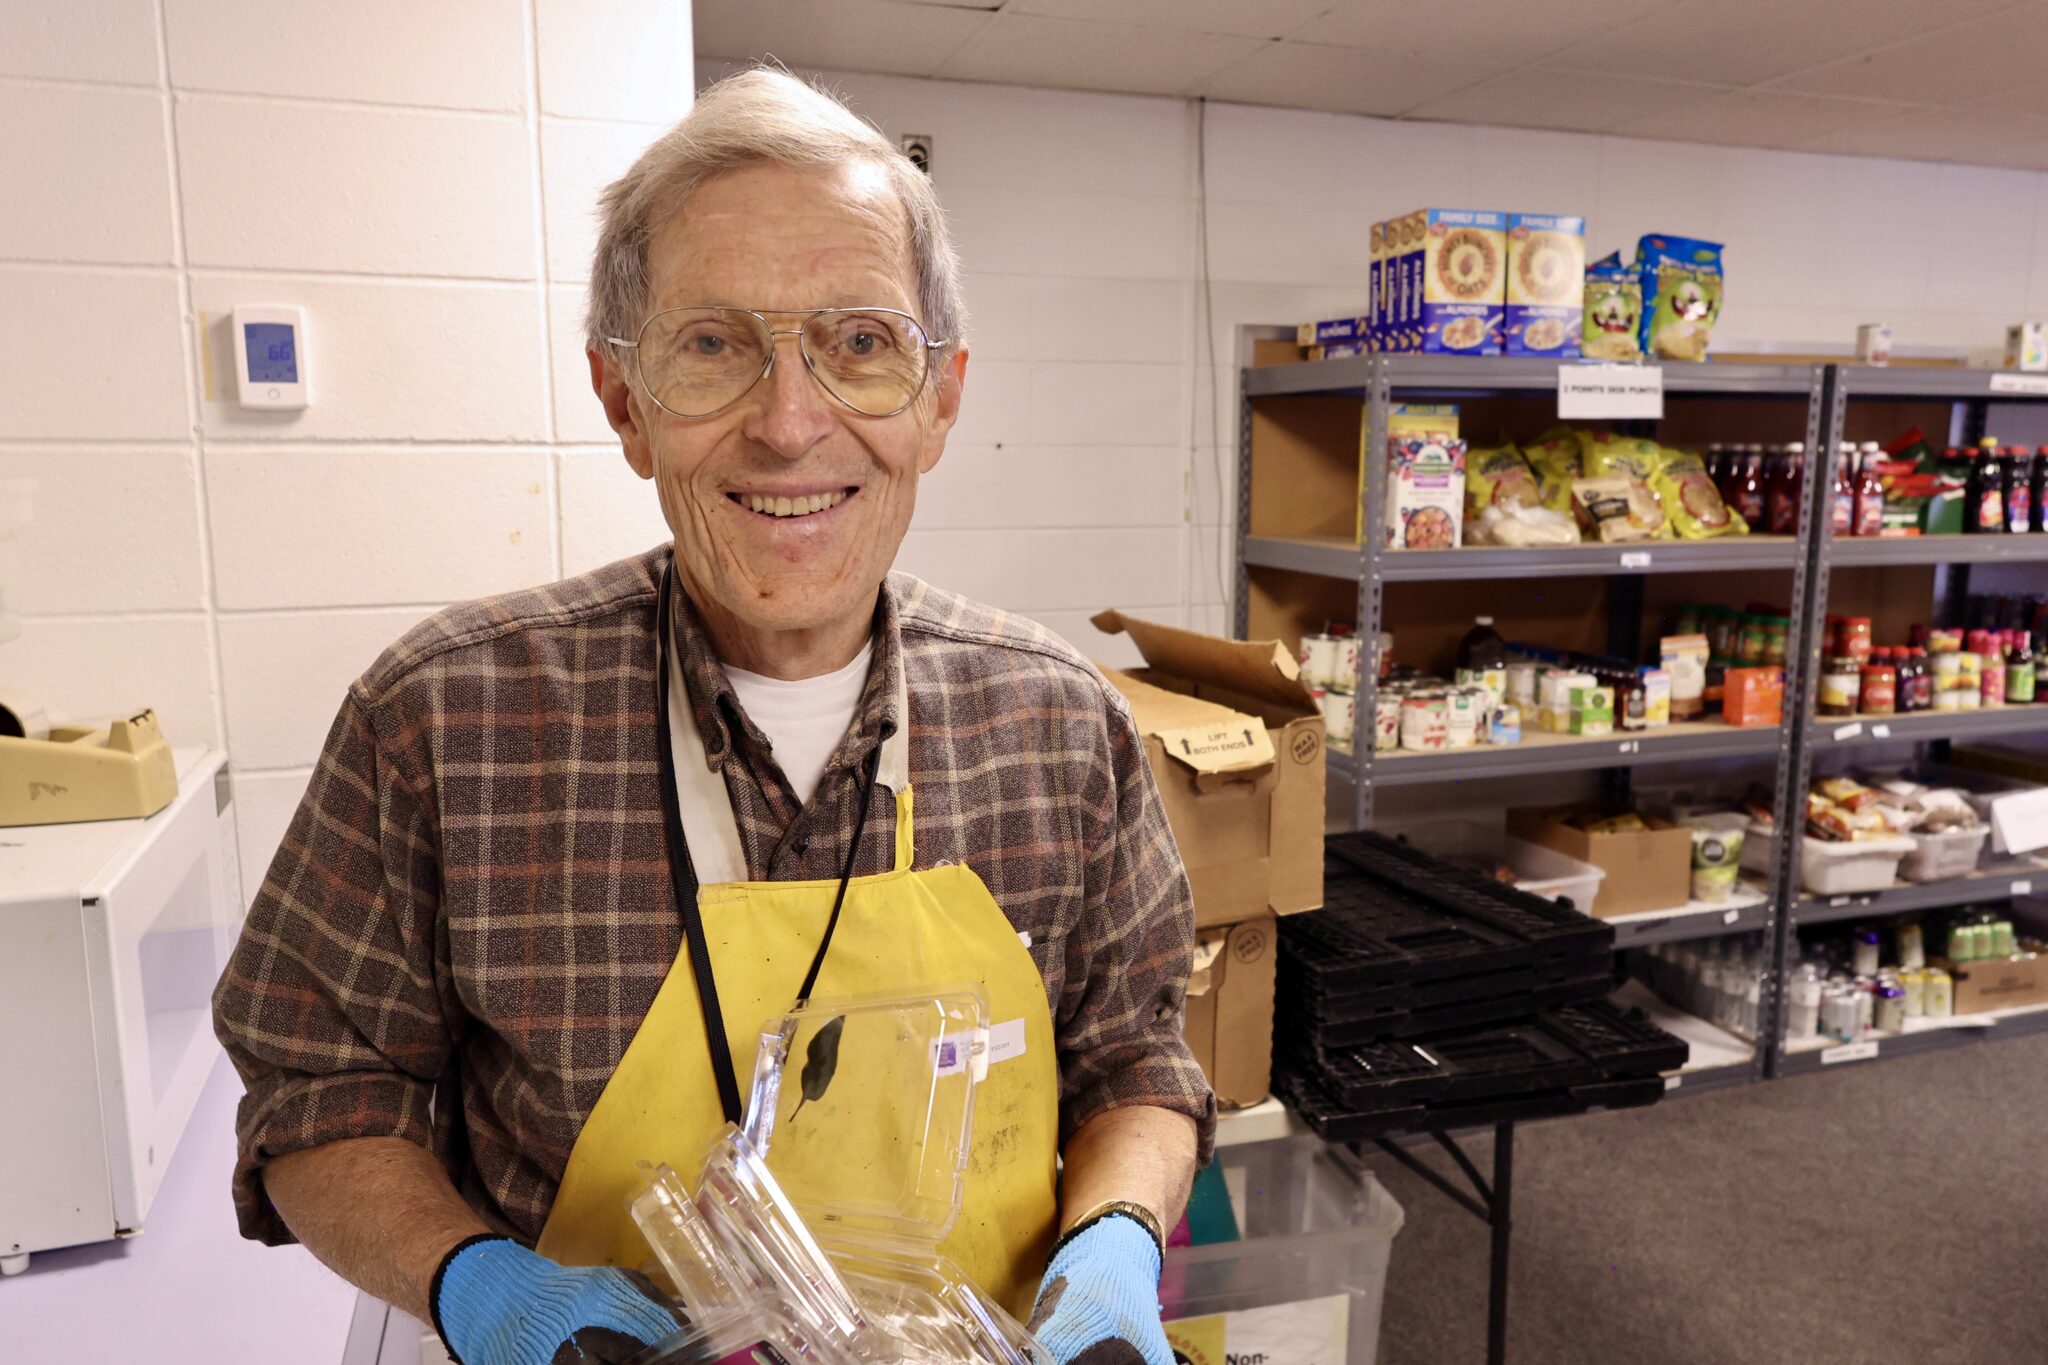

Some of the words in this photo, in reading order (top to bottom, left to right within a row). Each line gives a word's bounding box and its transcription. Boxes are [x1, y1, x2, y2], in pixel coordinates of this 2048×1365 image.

[1571, 385, 1604, 394] POINTS
[1208, 732, 1227, 742] LIFT
[1193, 745, 1219, 755] BOTH
[1221, 741, 1246, 751] ENDS
[1225, 1353, 1269, 1365] Non-
